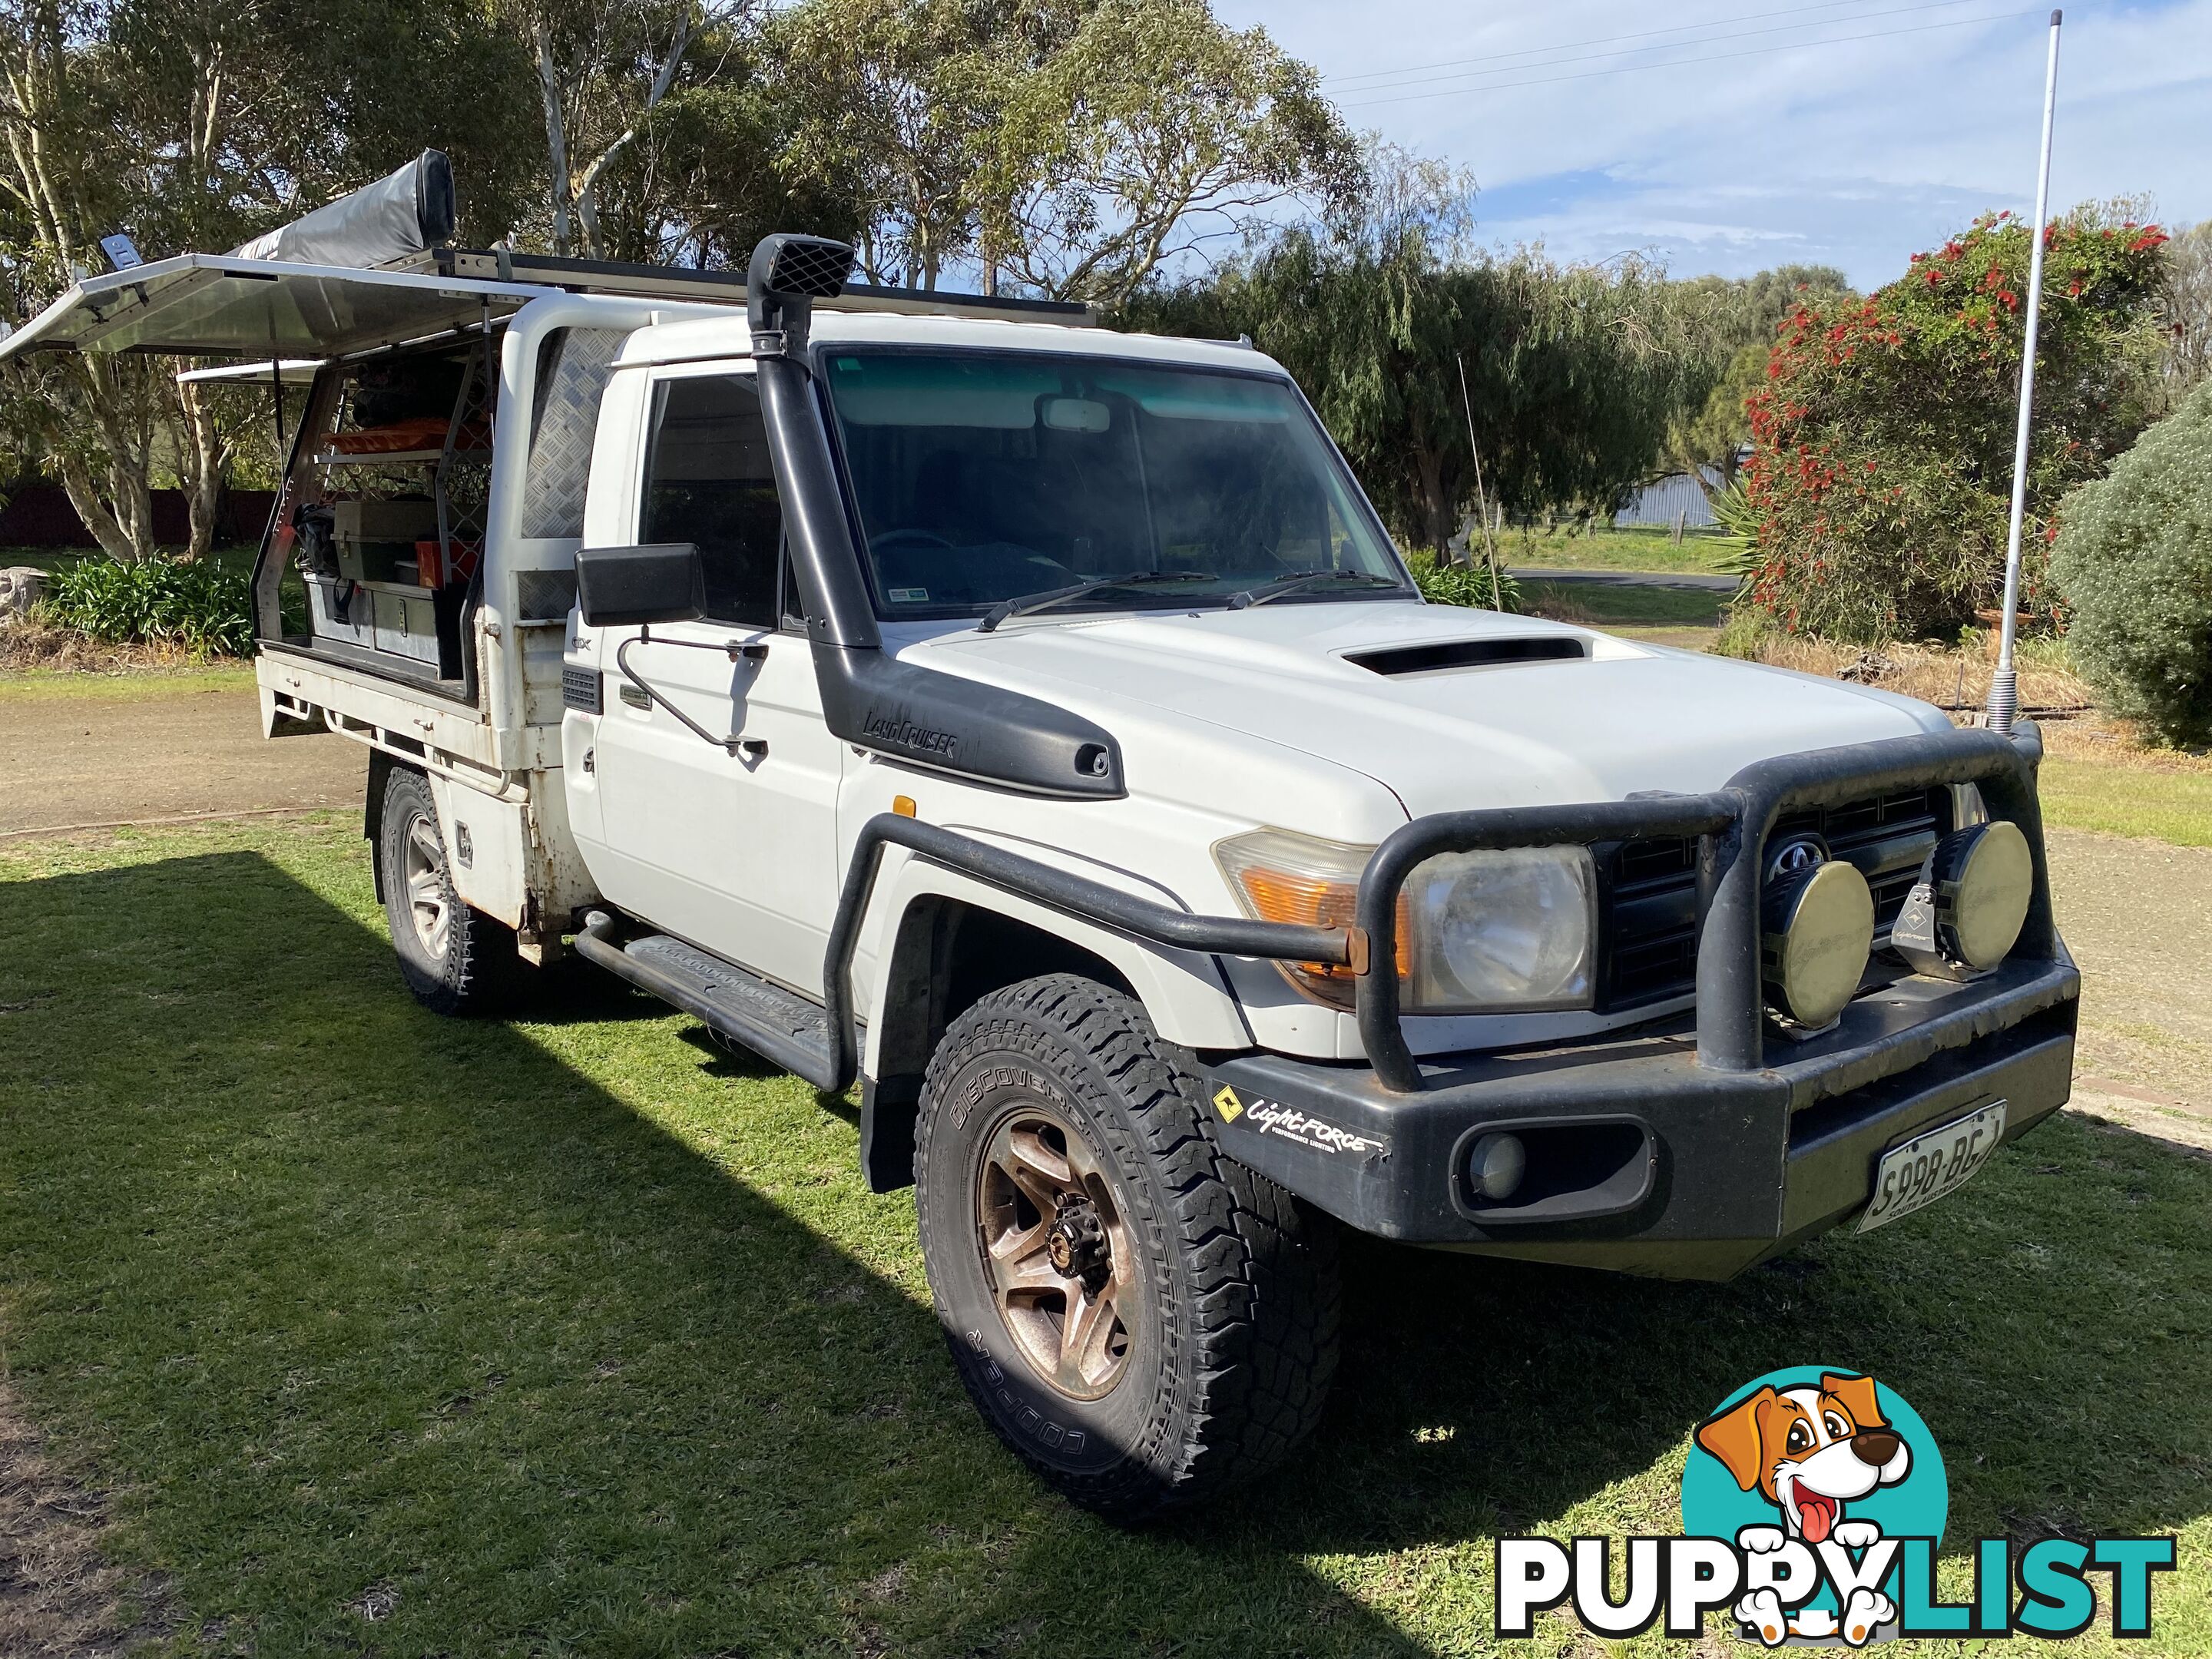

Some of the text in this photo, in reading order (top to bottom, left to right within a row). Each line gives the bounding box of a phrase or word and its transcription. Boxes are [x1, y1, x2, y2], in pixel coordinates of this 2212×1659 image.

[949, 1066, 1120, 1161] DISCOVERER
[1271, 1126, 1336, 1154] PERFORMANCE LIGHTING
[1886, 1200, 1919, 1220] SOUTH
[965, 1329, 1085, 1455] COOPER
